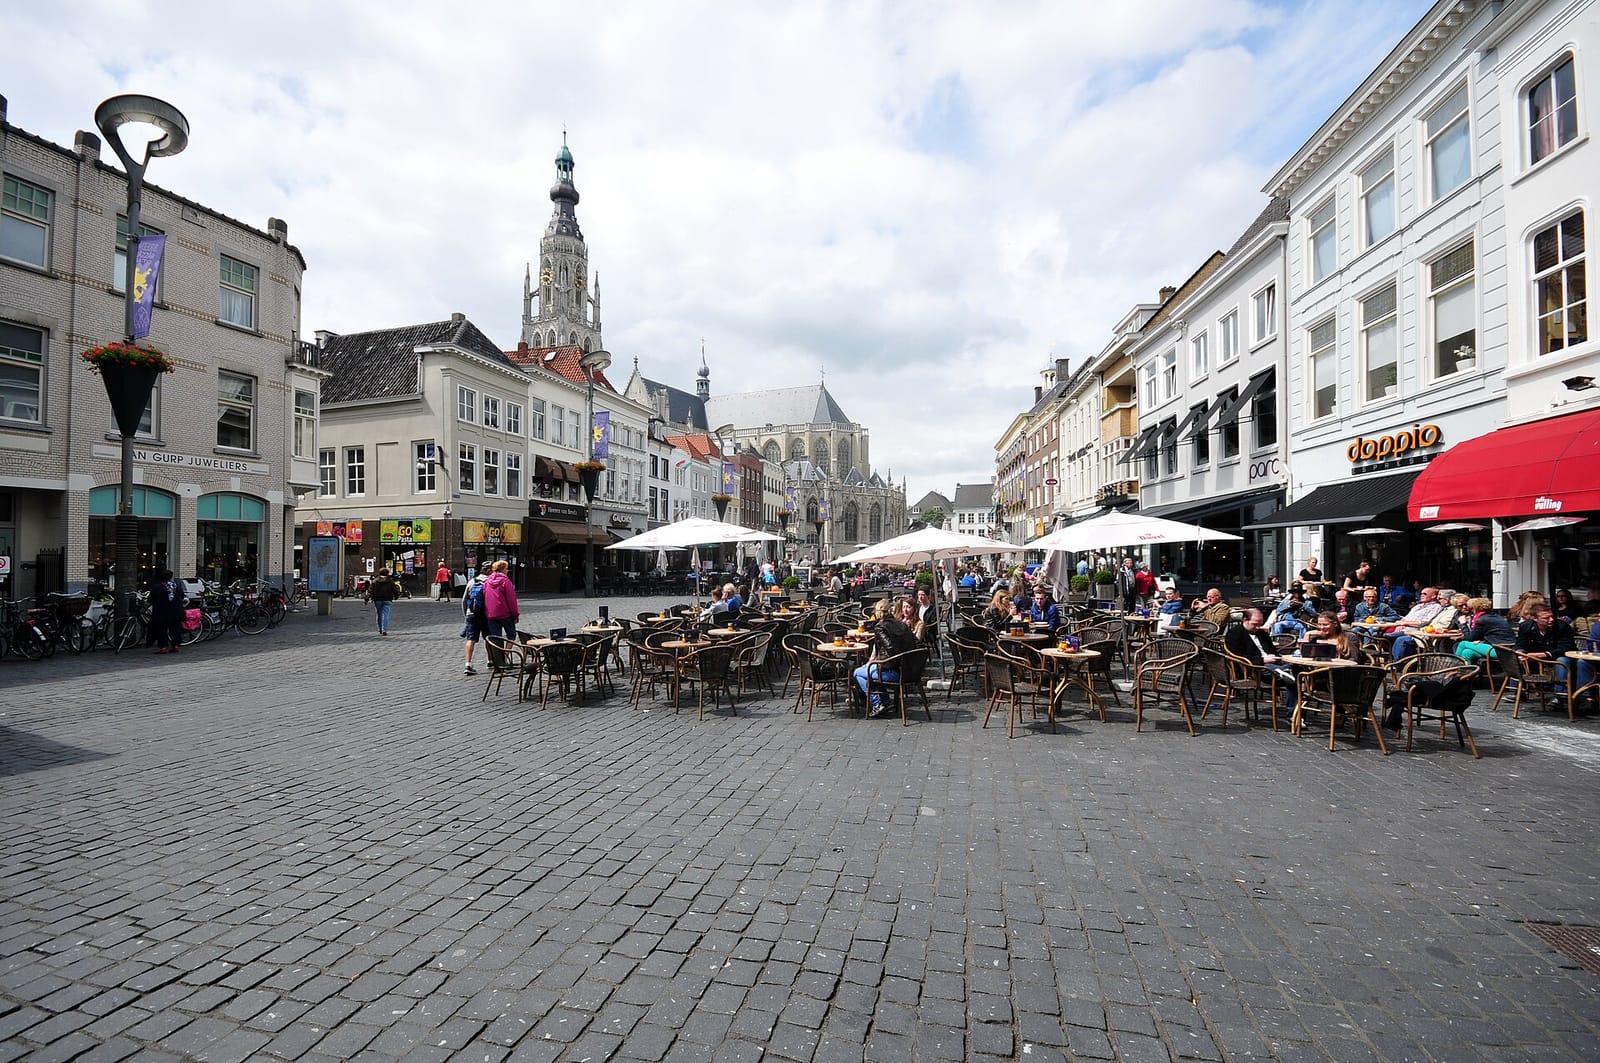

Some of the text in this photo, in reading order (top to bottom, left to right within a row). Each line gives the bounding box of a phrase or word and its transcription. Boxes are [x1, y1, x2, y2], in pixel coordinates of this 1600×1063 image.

[1347, 424, 1441, 462] doppio
[132, 450, 248, 471] AN GURP JUWELIERS
[1250, 458, 1280, 485] parc
[398, 525, 412, 537] GO
[488, 527, 500, 537] GO
